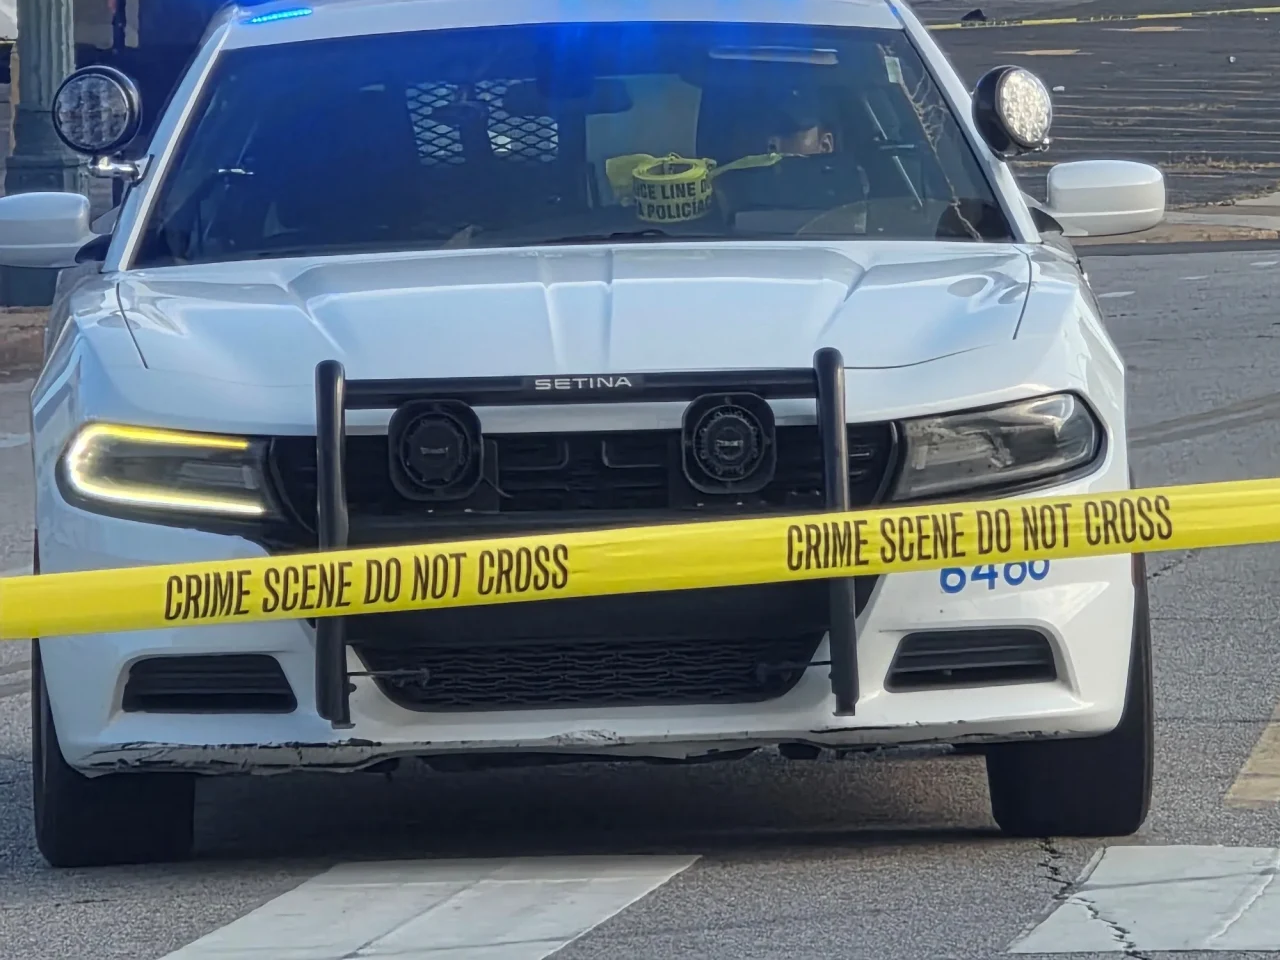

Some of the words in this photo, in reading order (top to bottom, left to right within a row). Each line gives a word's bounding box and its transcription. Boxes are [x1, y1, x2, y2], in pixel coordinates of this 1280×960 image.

[661, 182, 696, 199] LINE
[535, 376, 632, 390] SETINA
[787, 519, 869, 571] CRIME
[880, 511, 966, 564] SCENE
[976, 508, 1011, 556] DO
[1022, 502, 1072, 551] NOT
[1084, 494, 1173, 546] CROSS
[164, 569, 253, 620] CRIME
[262, 561, 354, 613] SCENE
[363, 557, 401, 604] DO
[411, 551, 467, 600] NOT
[477, 543, 570, 595] CROSS
